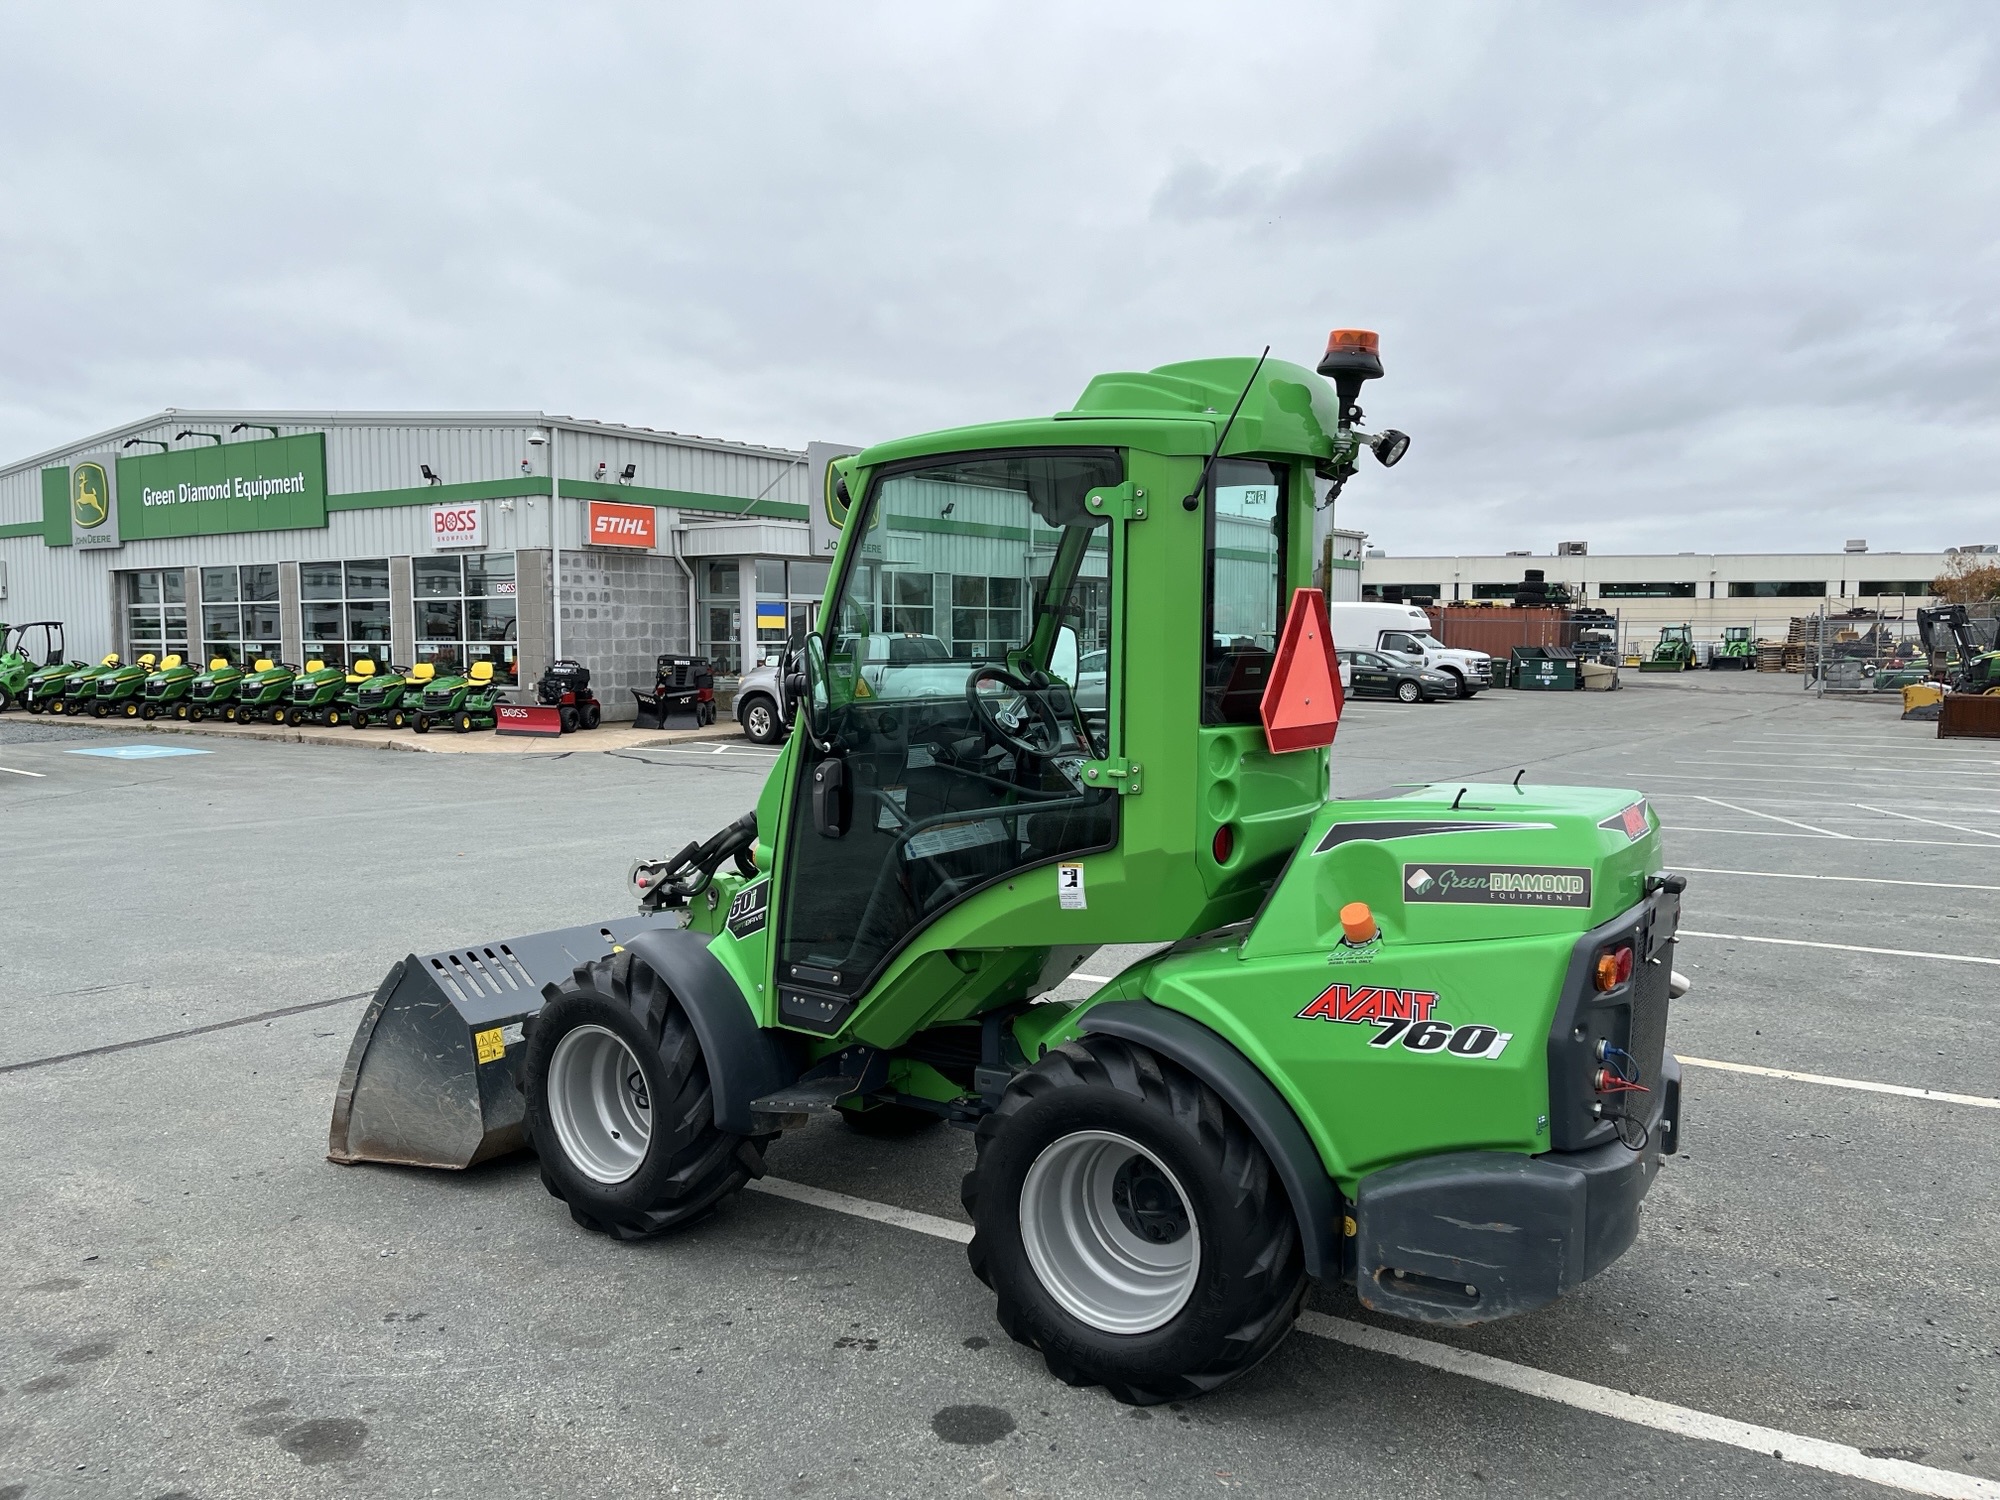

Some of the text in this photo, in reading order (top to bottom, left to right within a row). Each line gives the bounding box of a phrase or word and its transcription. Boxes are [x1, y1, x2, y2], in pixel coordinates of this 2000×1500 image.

[143, 471, 305, 507] Green Diamond Equipment
[434, 509, 476, 534] BOSS
[594, 516, 648, 536] STIHL
[74, 534, 112, 546] JOHN DEERE
[437, 534, 474, 542] SNOWPLOW
[824, 539, 882, 554] JO EERE
[496, 583, 516, 593] BOSS
[500, 707, 529, 718] BOSS
[1438, 868, 1584, 896] Green DIAMOND
[1490, 891, 1573, 902] EQUIPMENT
[1293, 982, 1438, 1023] AVANT
[1368, 1015, 1514, 1060] 760i
